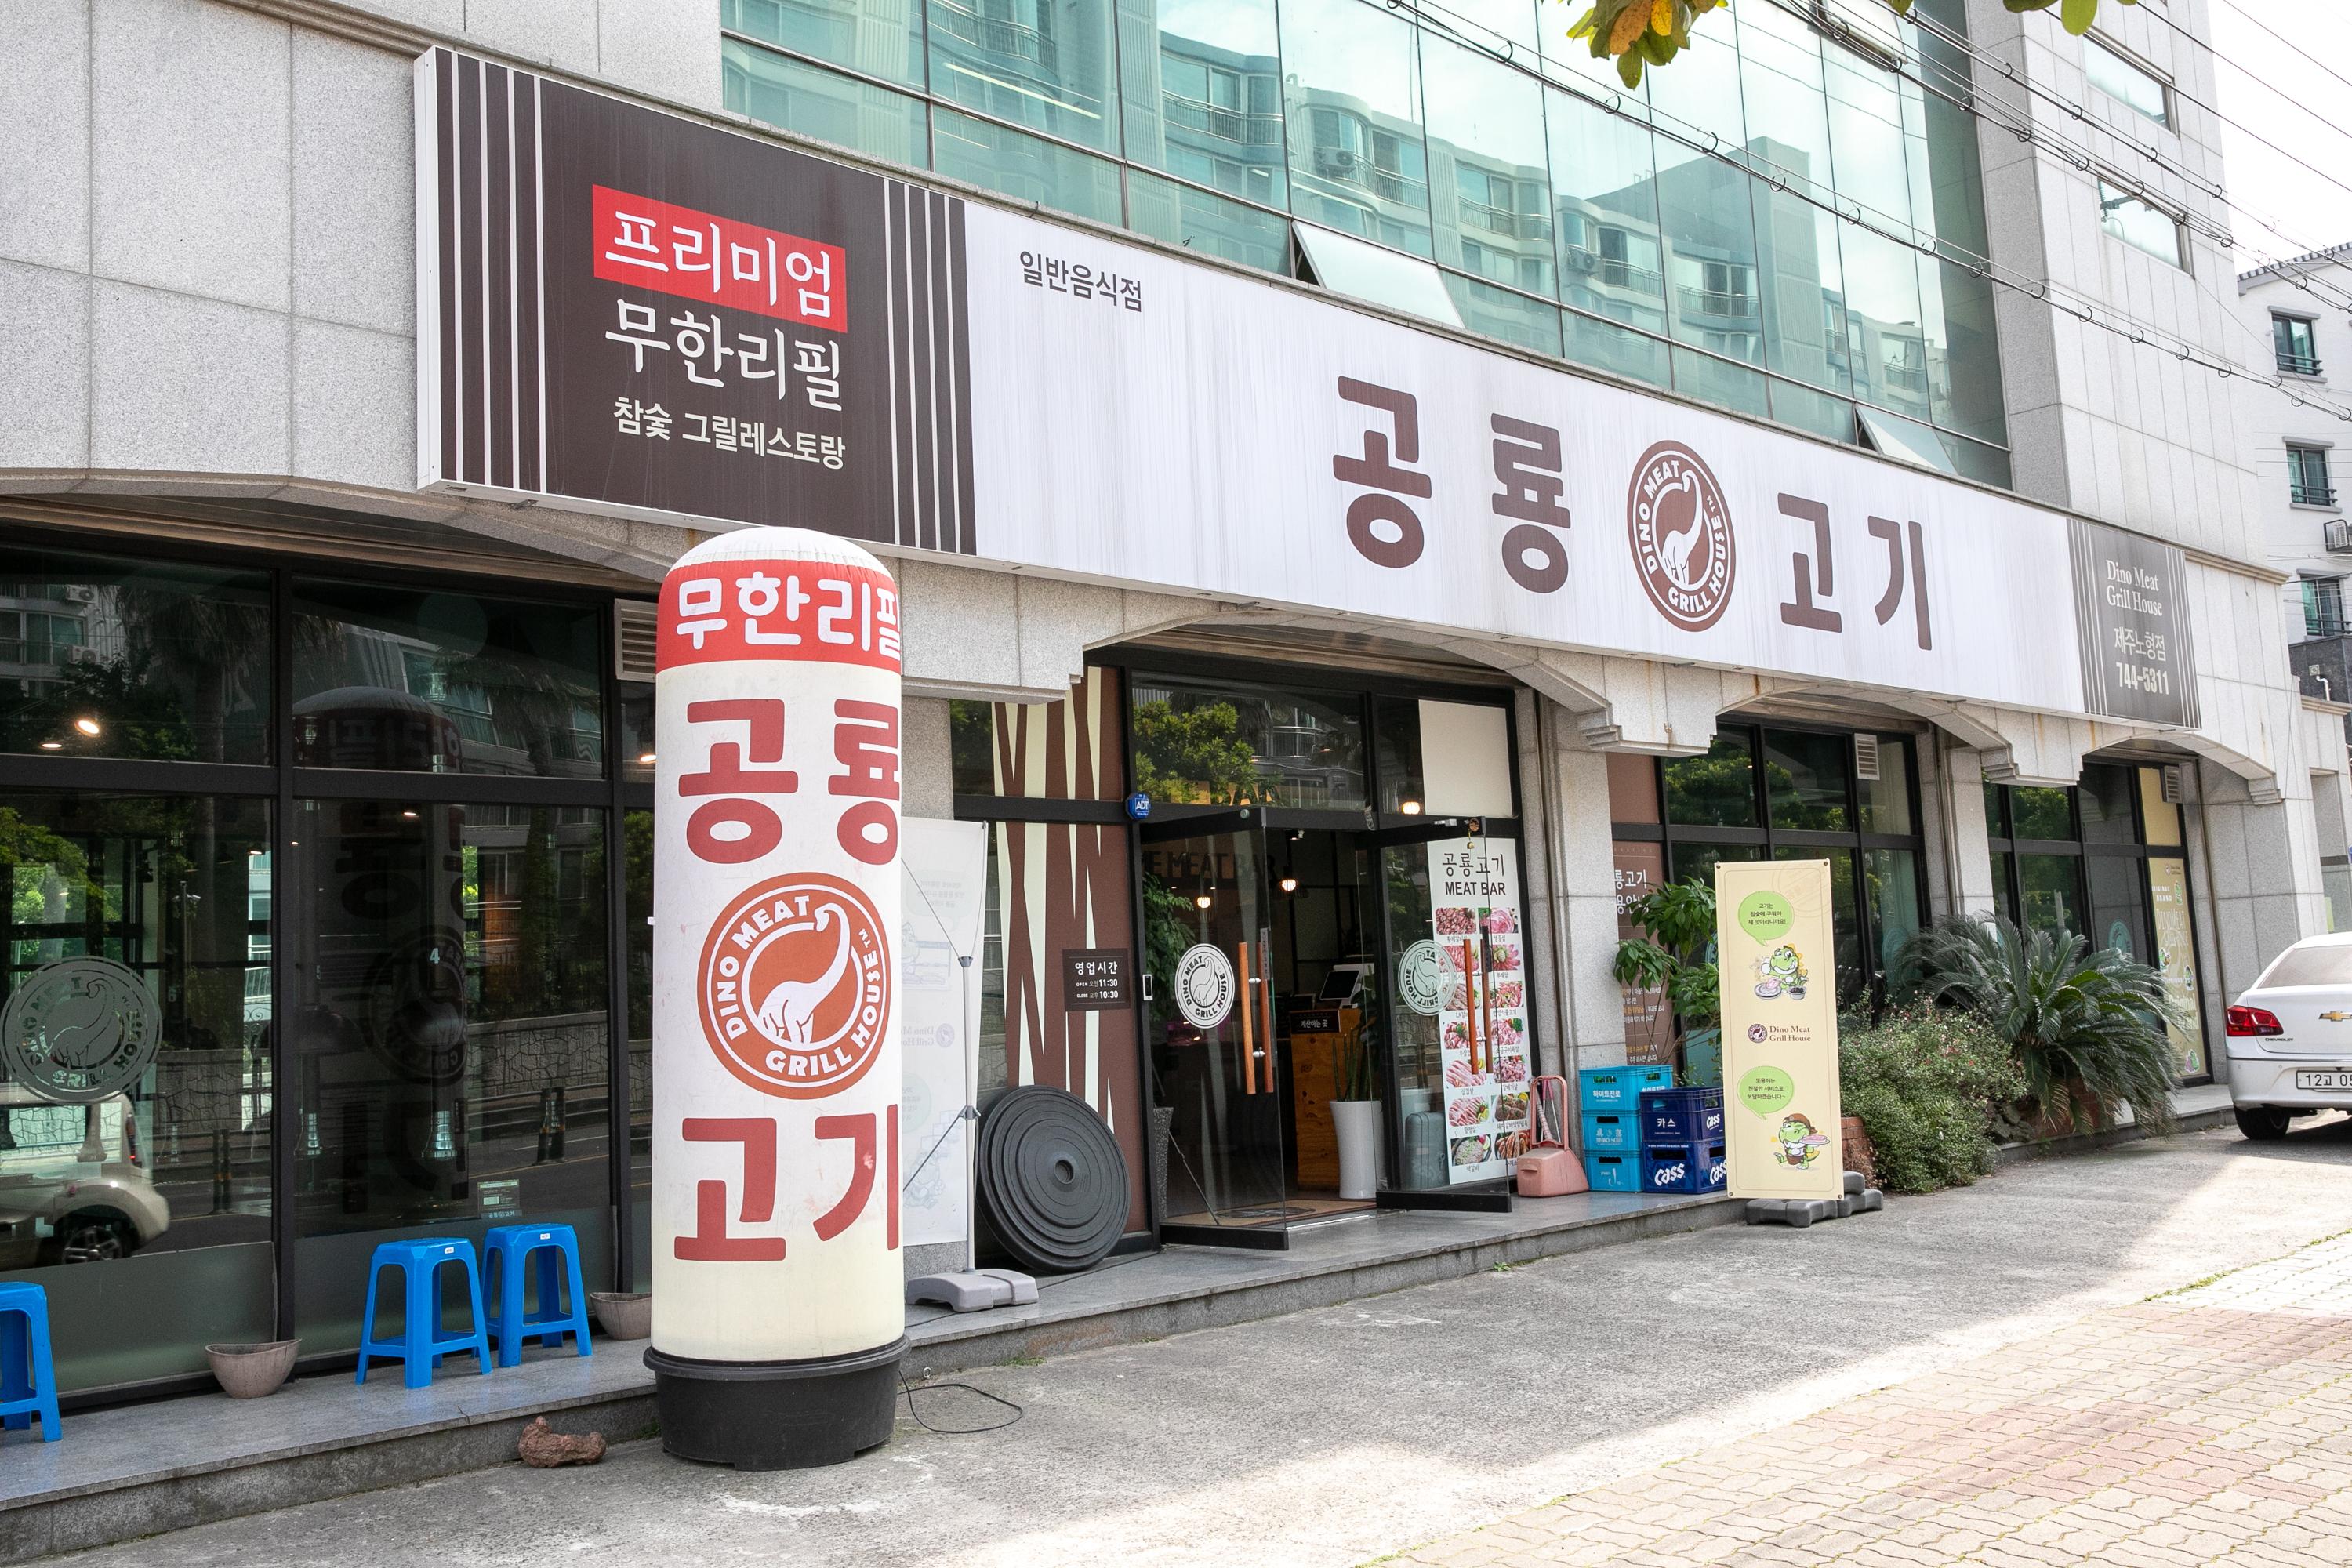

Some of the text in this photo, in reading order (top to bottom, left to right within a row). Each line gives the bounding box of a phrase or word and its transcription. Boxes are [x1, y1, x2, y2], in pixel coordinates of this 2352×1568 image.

[605, 209, 831, 319] 프리미엄
[1019, 251, 1143, 313] 일반음식점
[605, 298, 843, 412] 무한리필
[613, 397, 846, 470] 참숯 그릴레스토랑
[1333, 375, 1571, 593] 공룡
[1639, 460, 1679, 574] DINO MEAT
[1777, 492, 1932, 652] 고기
[2106, 559, 2159, 592] Dino Meat
[676, 571, 900, 661] 무한리필
[1668, 586, 1712, 613] GRILL
[2107, 586, 2163, 616] Grill House
[2114, 626, 2166, 662] 제주노형점
[2116, 662, 2169, 695] 744-5311
[678, 699, 900, 866] 공룡
[1135, 800, 1149, 810] ADT
[1442, 852, 1504, 877] 공룡고기
[1614, 869, 1647, 890] 룡고기
[1445, 881, 1506, 895] MEAT BAR
[717, 895, 811, 1040] DINO MEAT
[1075, 961, 1117, 975] 영업시간
[1098, 978, 1118, 987] 11:30
[1183, 956, 1202, 1006] DINO MEAT
[1099, 990, 1119, 999] 10:30
[765, 1049, 853, 1077] GRILL
[850, 949, 881, 1049] HOUSE
[1195, 1007, 1218, 1018] GRILL
[1301, 1019, 1327, 1029] 계산하는 곳
[1657, 1118, 1676, 1128] 카스
[1706, 1113, 1720, 1129] Cass
[674, 1104, 899, 1261] 고기
[1654, 1163, 1685, 1186] Cass
